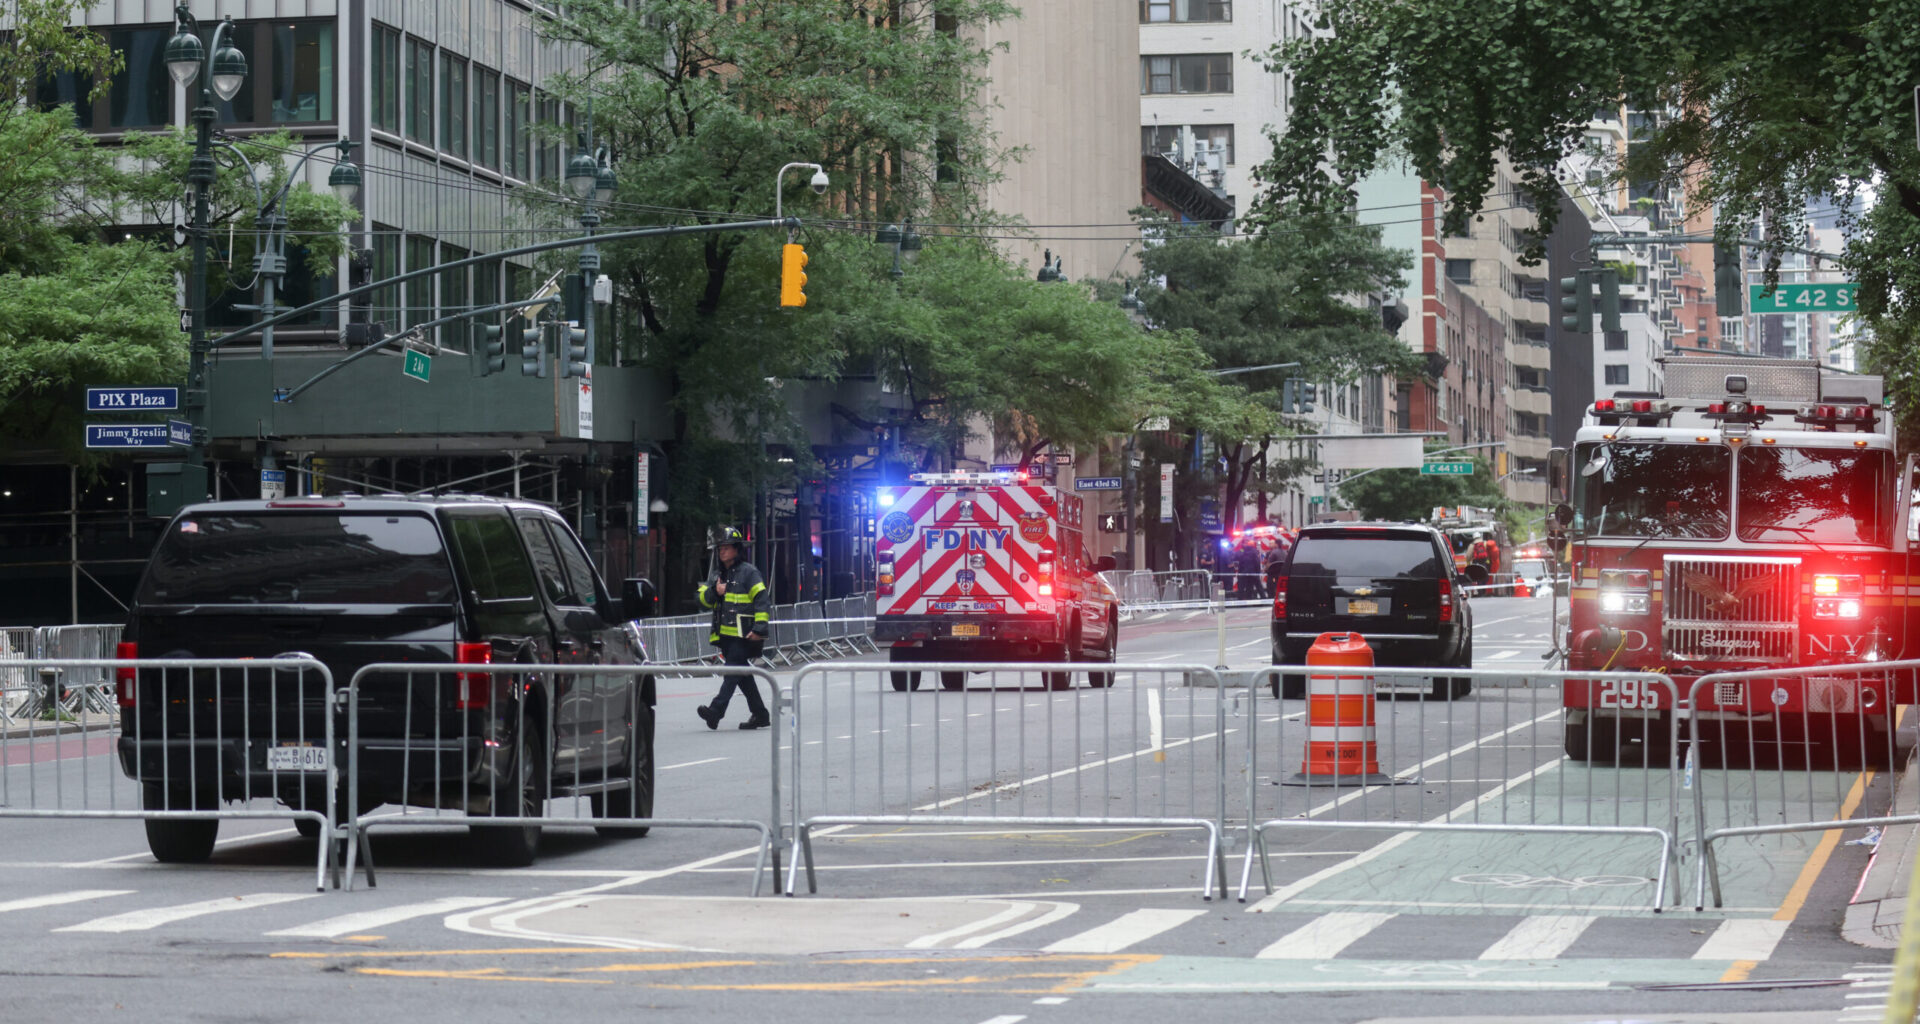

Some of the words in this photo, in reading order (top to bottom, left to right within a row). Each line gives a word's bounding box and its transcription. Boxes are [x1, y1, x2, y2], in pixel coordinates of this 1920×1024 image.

[1775, 289, 1788, 307] E
[1795, 289, 1827, 307] 42
[413, 357, 418, 372] 2
[99, 393, 126, 406] PIX
[130, 393, 166, 406] Plaza
[97, 428, 130, 438] Jimmy
[132, 427, 168, 437] Breslin
[1429, 464, 1436, 472] E
[1437, 464, 1450, 472] 44
[1078, 480, 1094, 488] East
[1095, 479, 1110, 488] 43rd
[1110, 479, 1119, 487] St
[1023, 526, 1044, 534] FIRE
[934, 602, 957, 610] KEEP
[973, 602, 997, 610] BACK
[1700, 633, 1761, 654] Seagrave
[1600, 679, 1659, 709] 295
[1342, 750, 1357, 759] DOT
